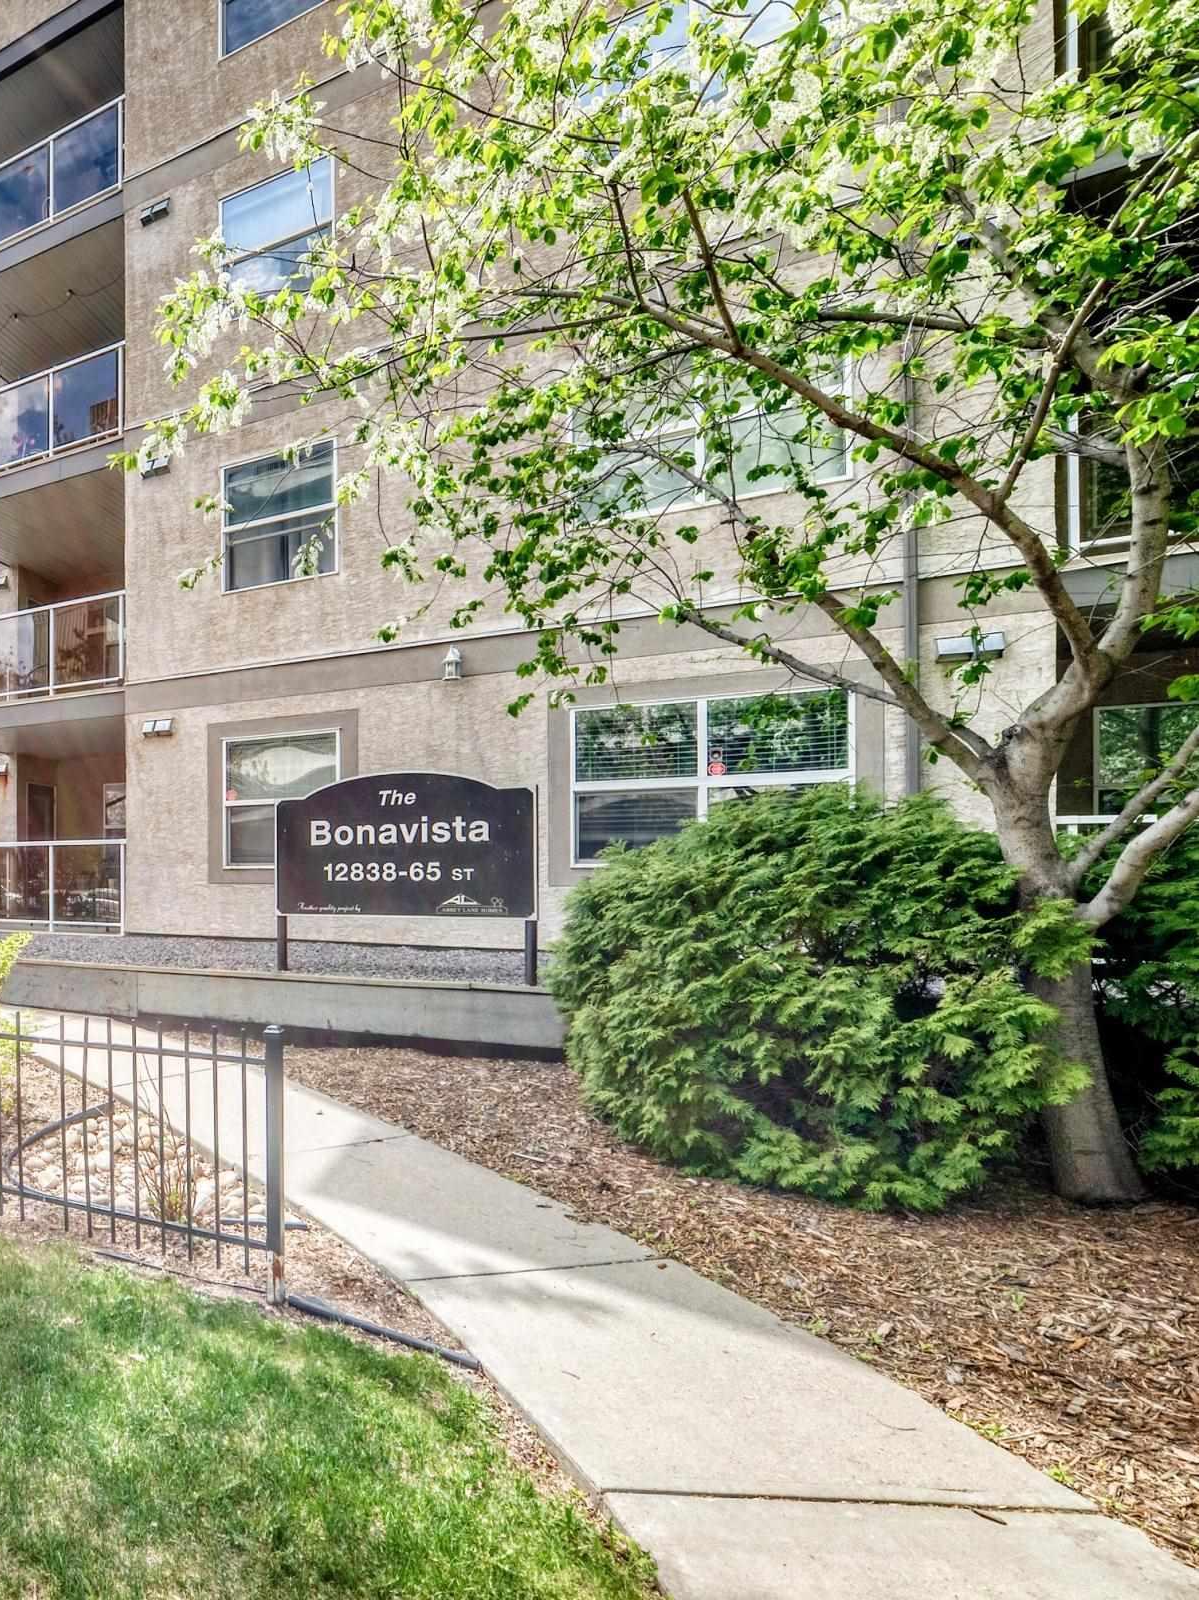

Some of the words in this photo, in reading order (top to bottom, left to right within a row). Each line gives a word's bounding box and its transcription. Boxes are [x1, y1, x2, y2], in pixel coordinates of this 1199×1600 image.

[377, 789, 417, 807] The
[309, 815, 490, 846] Bonavista
[323, 861, 442, 882] 12838-65
[451, 867, 475, 881] ST
